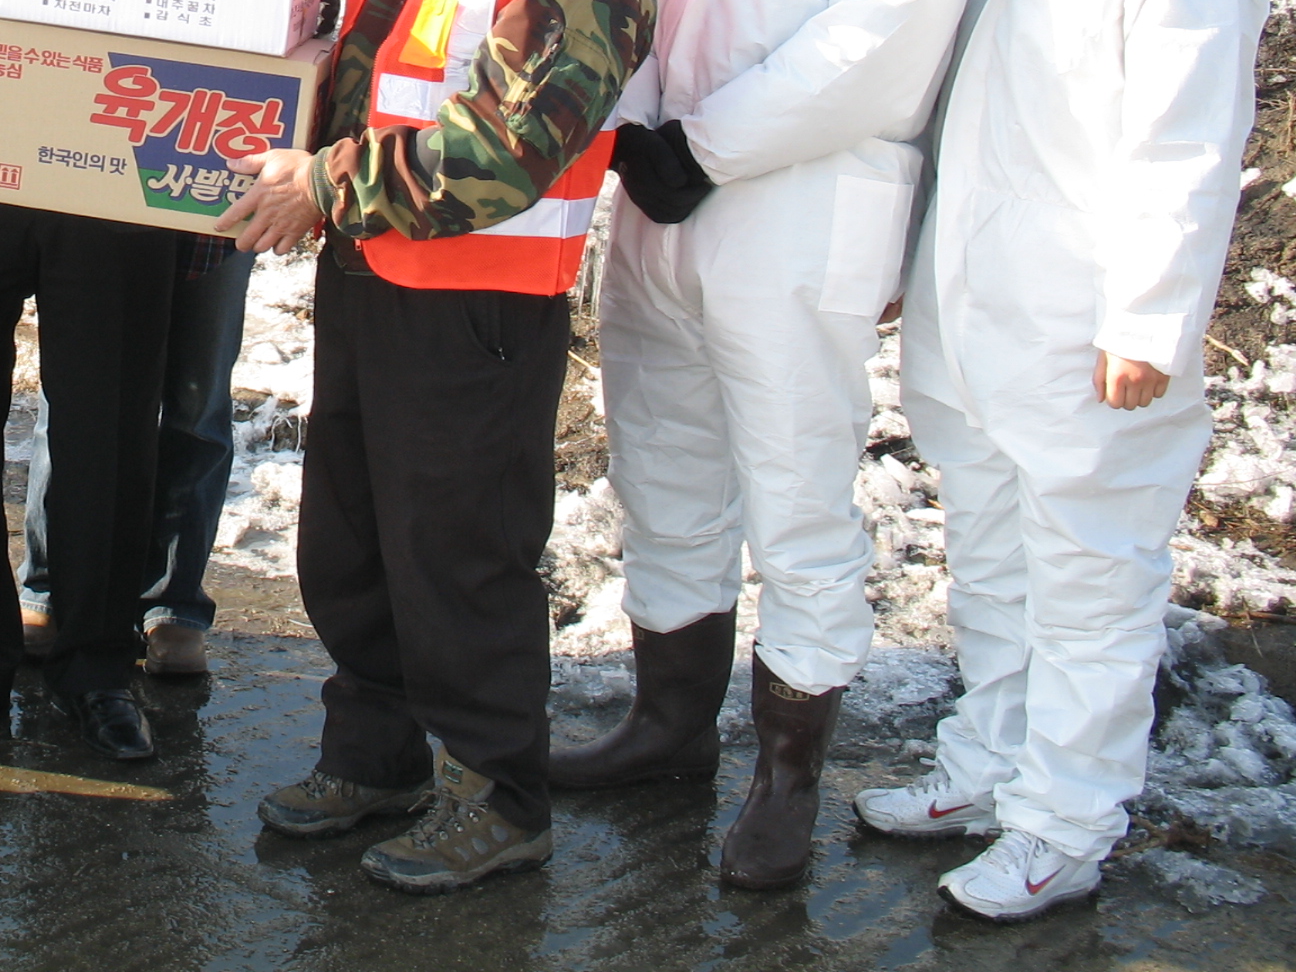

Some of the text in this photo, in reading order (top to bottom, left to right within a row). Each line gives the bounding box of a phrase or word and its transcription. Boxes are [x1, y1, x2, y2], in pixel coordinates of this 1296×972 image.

[23, 47, 40, 65] 수
[40, 49, 71, 69] 있는
[72, 54, 104, 74] 식품
[89, 65, 285, 160] 육개장
[37, 145, 128, 176] 한국인의 맛
